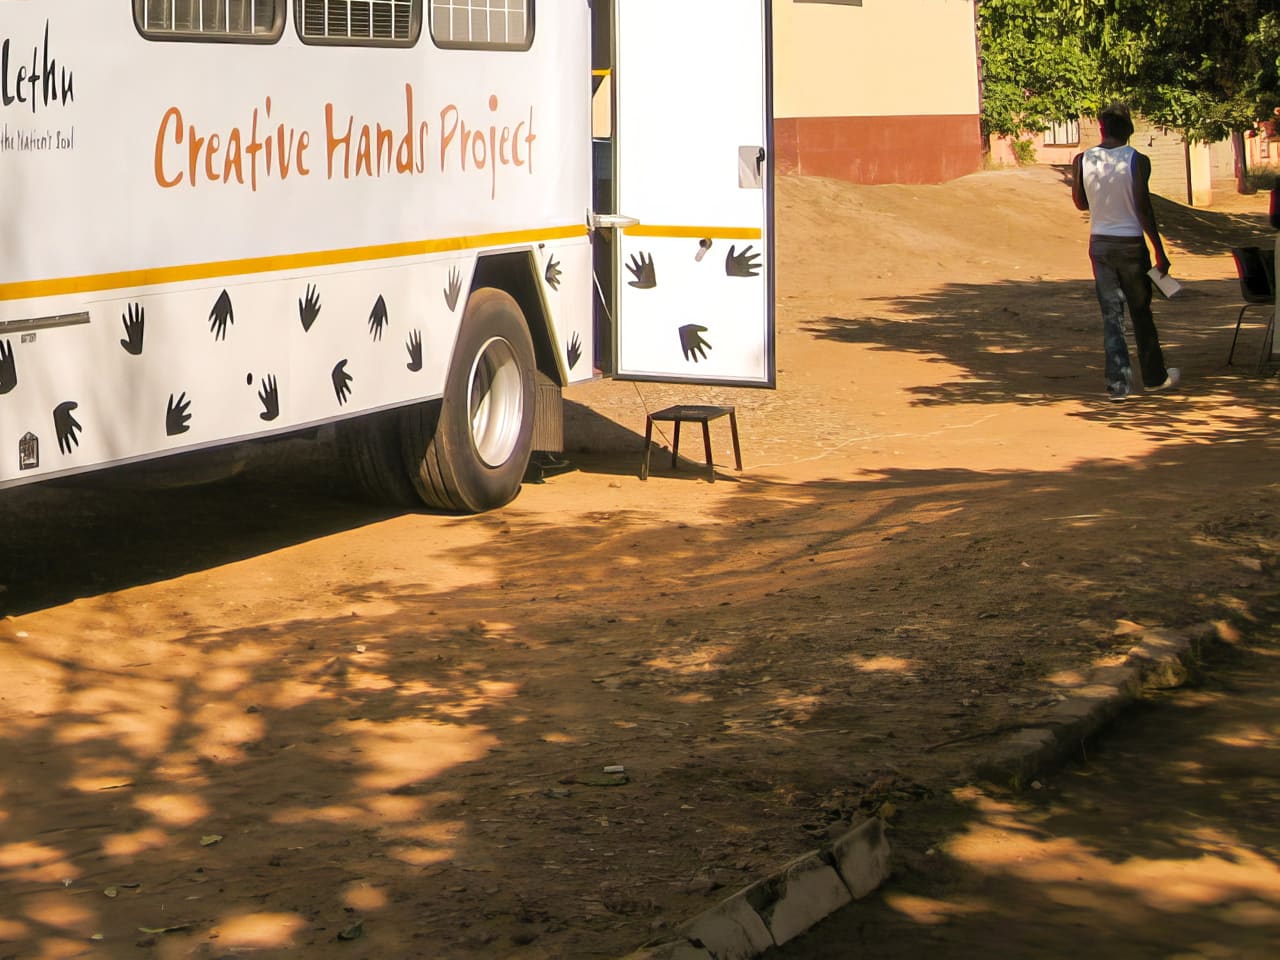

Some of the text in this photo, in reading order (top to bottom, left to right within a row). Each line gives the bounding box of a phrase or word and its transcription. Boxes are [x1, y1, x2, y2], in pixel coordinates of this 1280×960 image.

[1, 18, 74, 113] Lethu
[1, 123, 14, 152] the
[154, 82, 537, 200] Creative Hands Project
